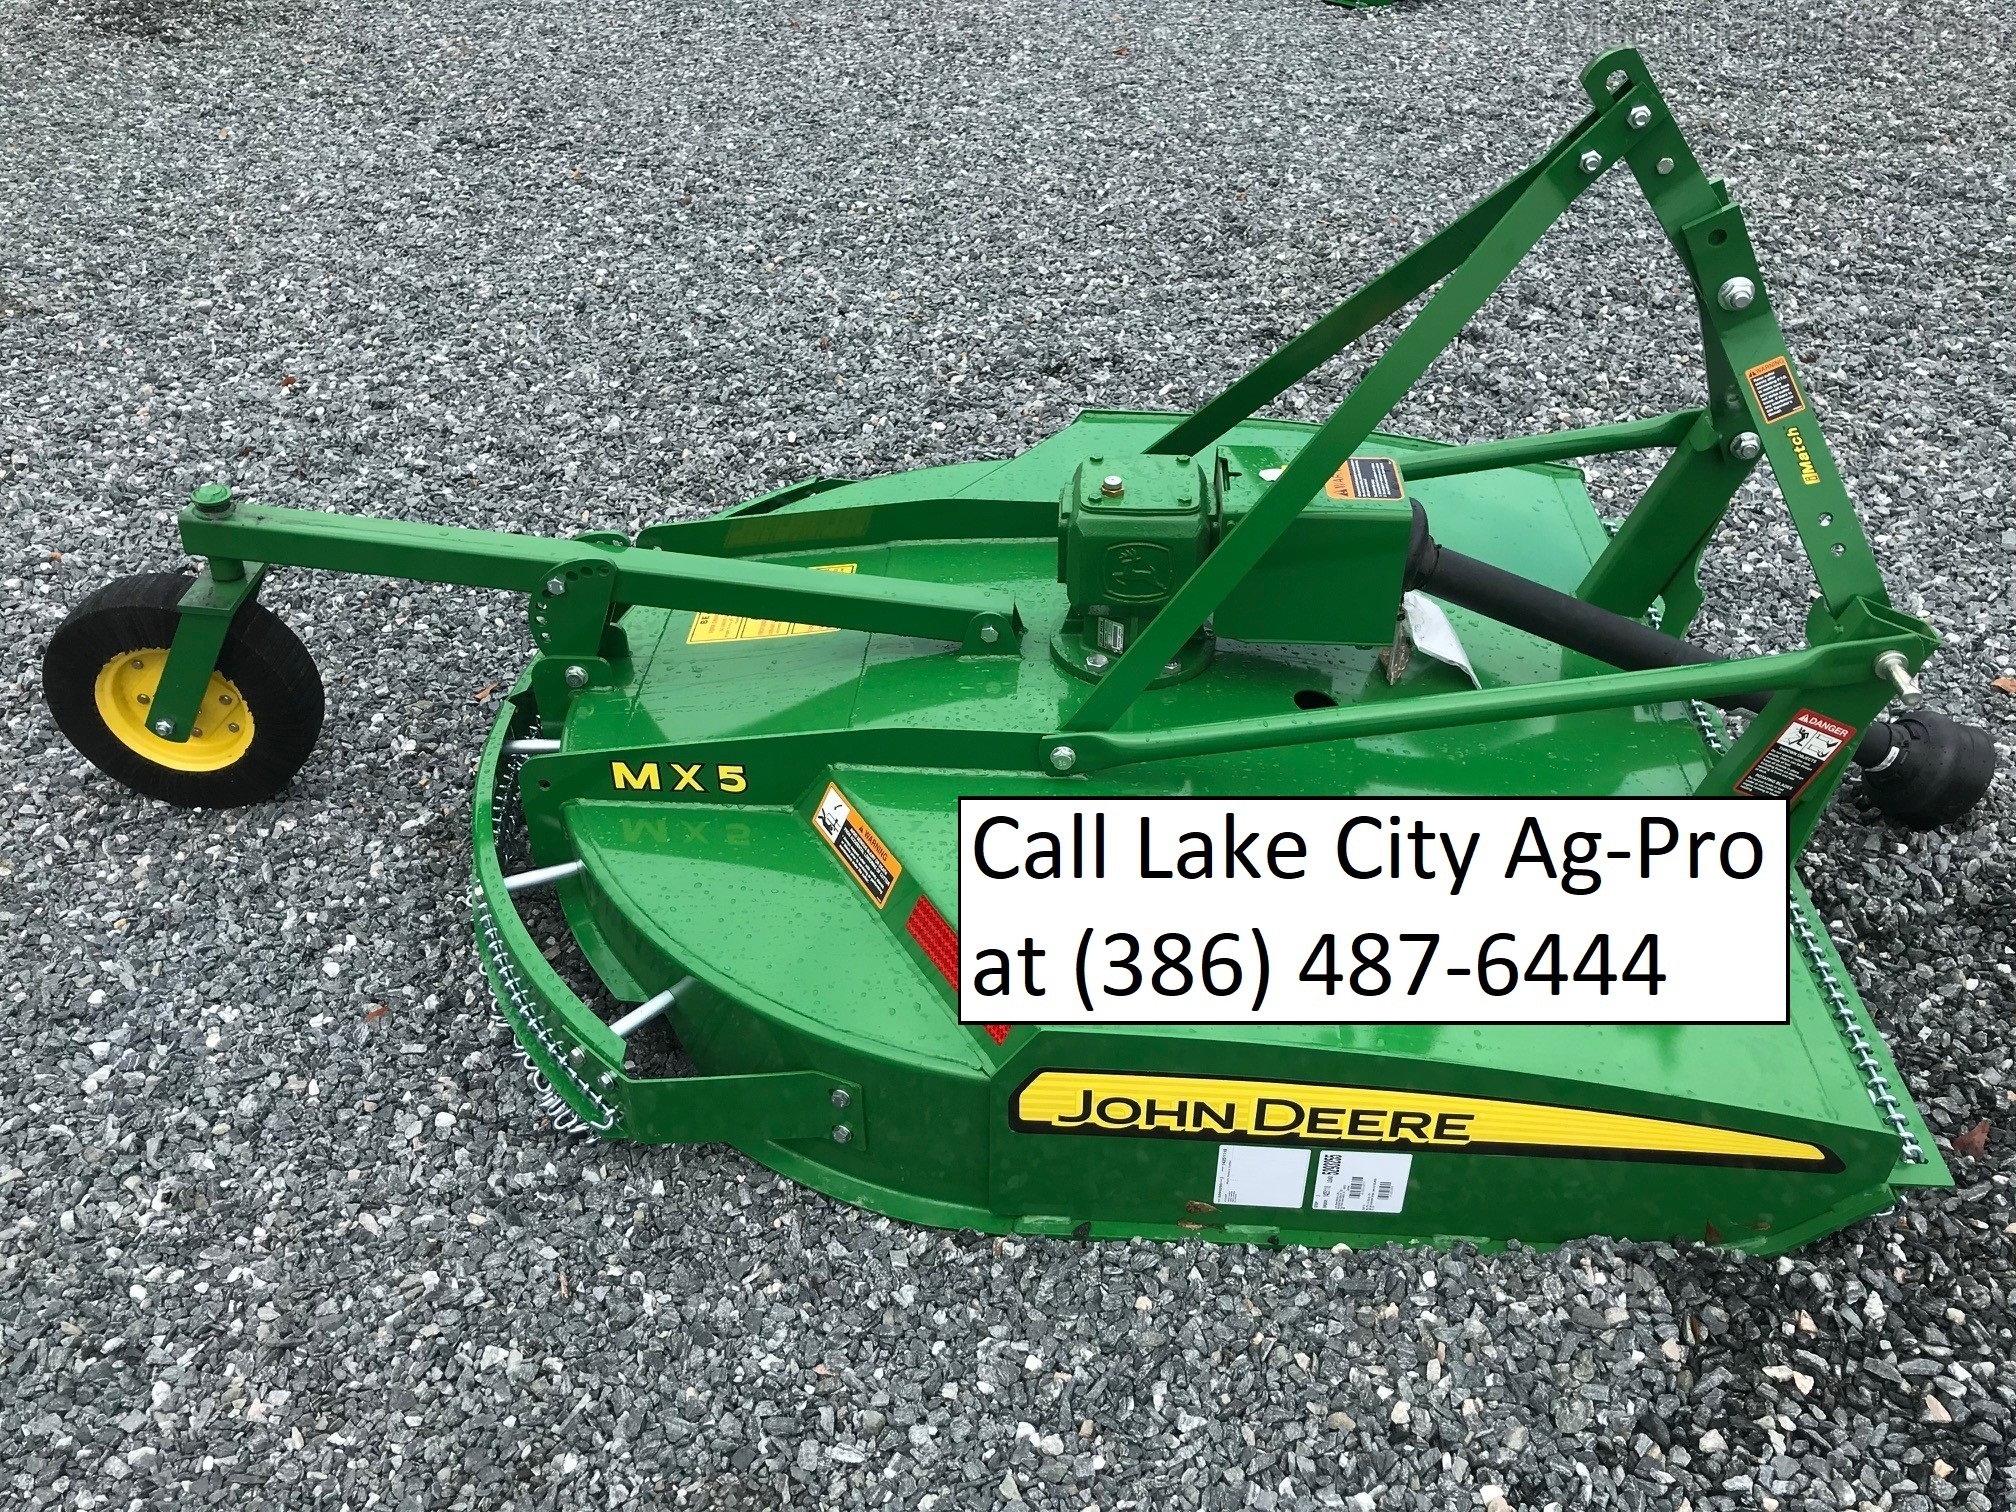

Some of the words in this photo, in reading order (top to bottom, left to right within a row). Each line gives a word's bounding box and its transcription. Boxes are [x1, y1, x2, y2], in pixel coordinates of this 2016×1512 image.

[1756, 359, 1784, 373] WARNING
[1787, 427, 1820, 485] iMatch
[1809, 718, 1849, 737] DANGER
[864, 830, 888, 862] WARNING
[1058, 1090, 1235, 1130] JOHN
[1248, 1098, 1475, 1141] DEERE
